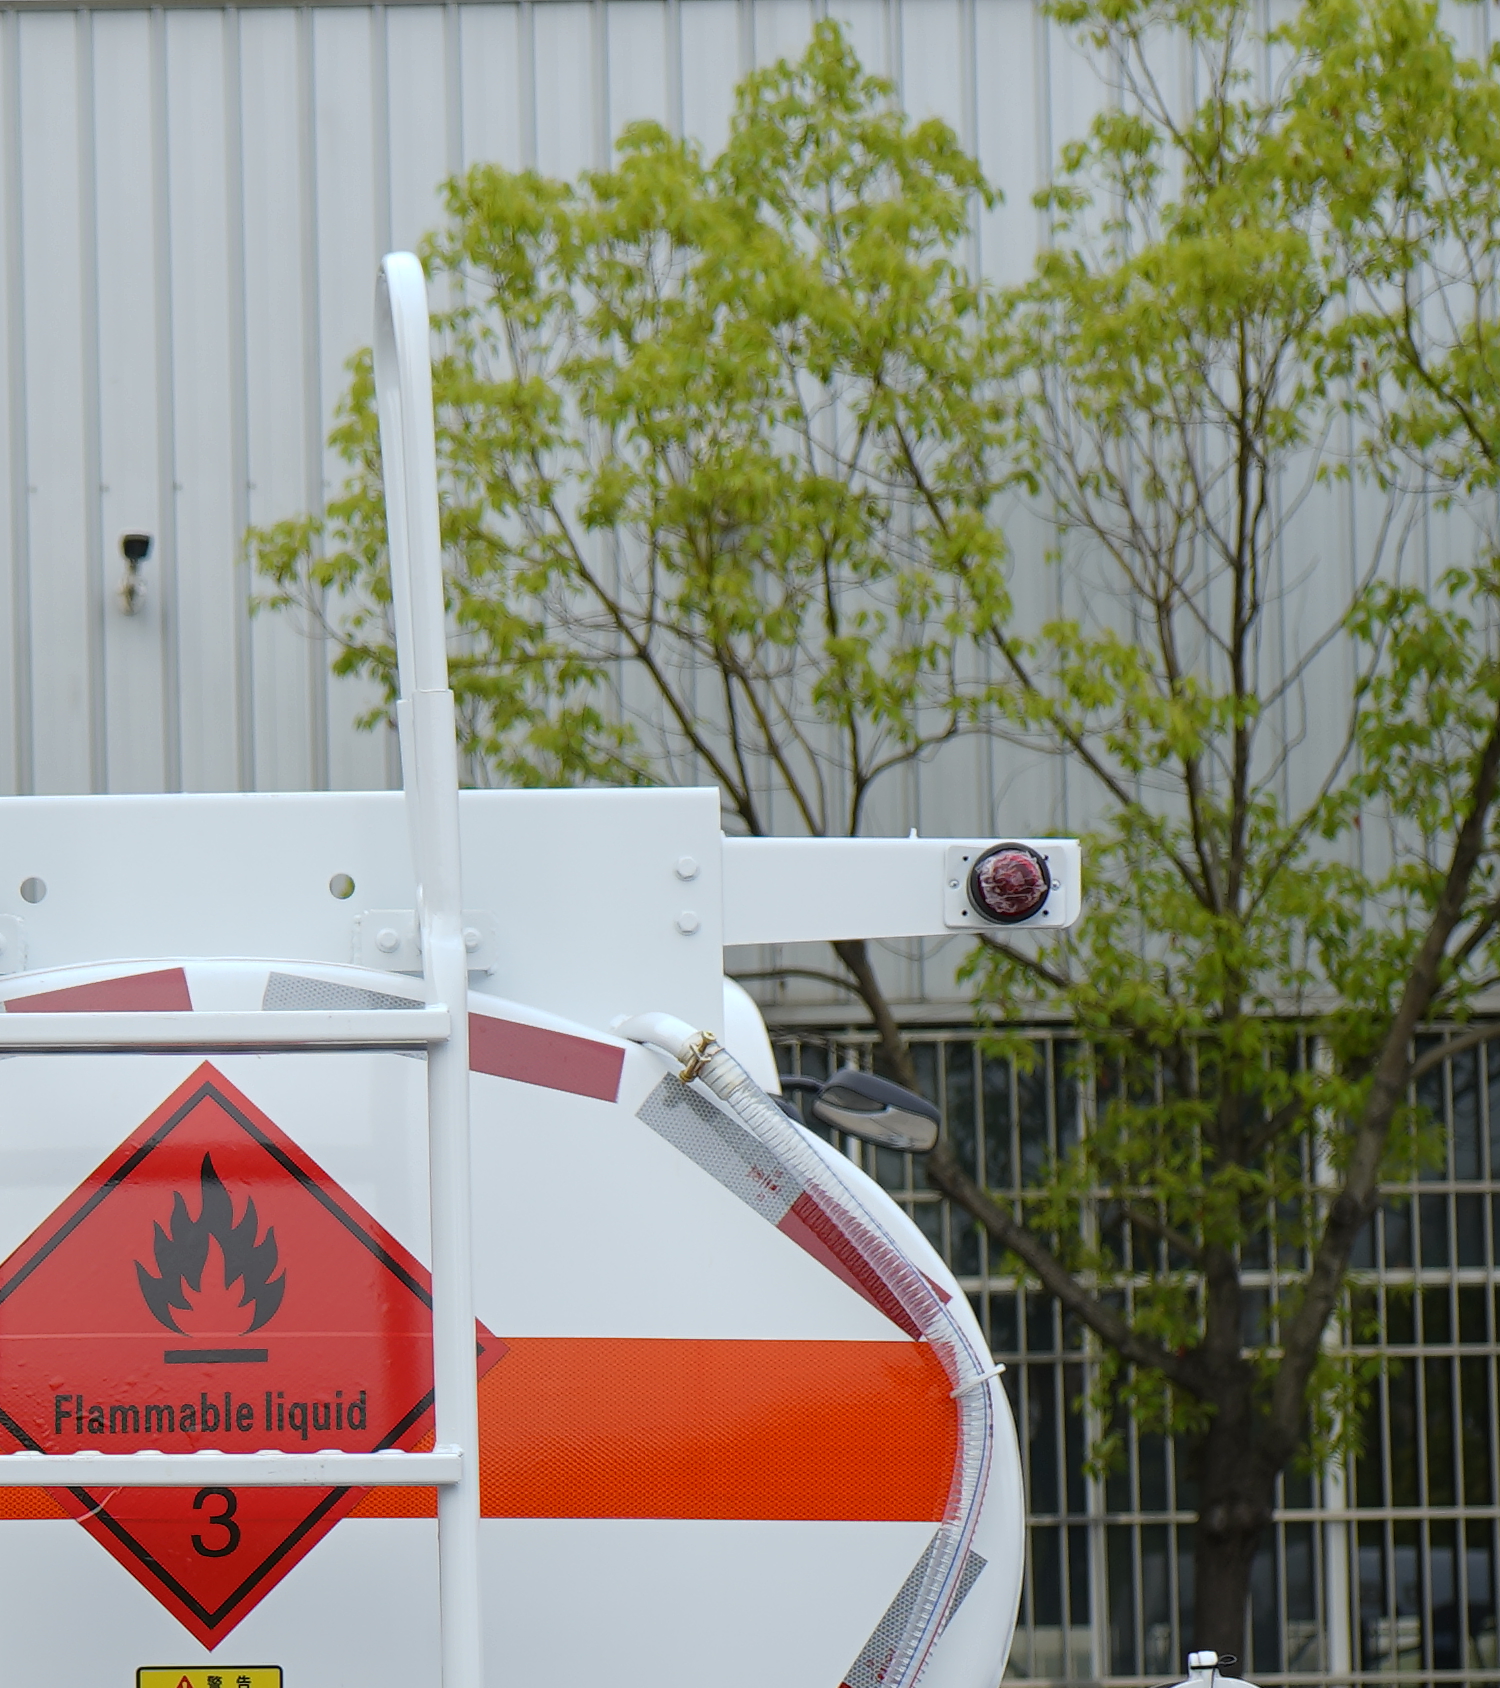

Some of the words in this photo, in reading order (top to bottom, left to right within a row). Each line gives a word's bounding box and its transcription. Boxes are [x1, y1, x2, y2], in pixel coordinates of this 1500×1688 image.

[53, 1391, 254, 1435] Flammable
[265, 1390, 367, 1440] liquid
[190, 1487, 241, 1558] 3
